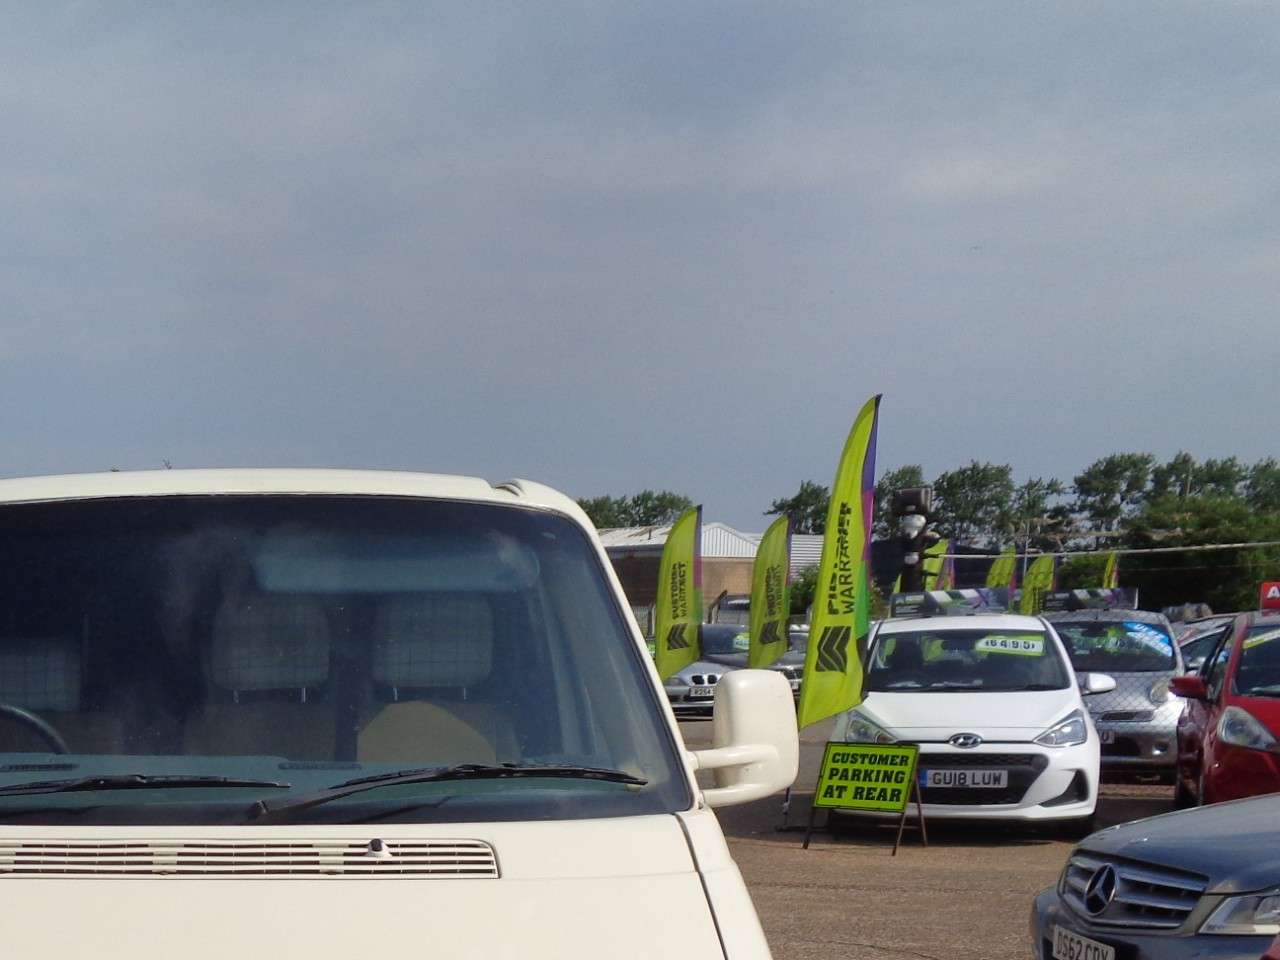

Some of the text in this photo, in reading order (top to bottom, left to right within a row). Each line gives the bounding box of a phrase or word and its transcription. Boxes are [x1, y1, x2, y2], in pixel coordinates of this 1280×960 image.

[831, 752, 910, 767] CUSTOMER
[828, 768, 906, 784] PARKING
[932, 772, 1002, 786] GU18 LUW
[822, 785, 903, 802] AT REAR
